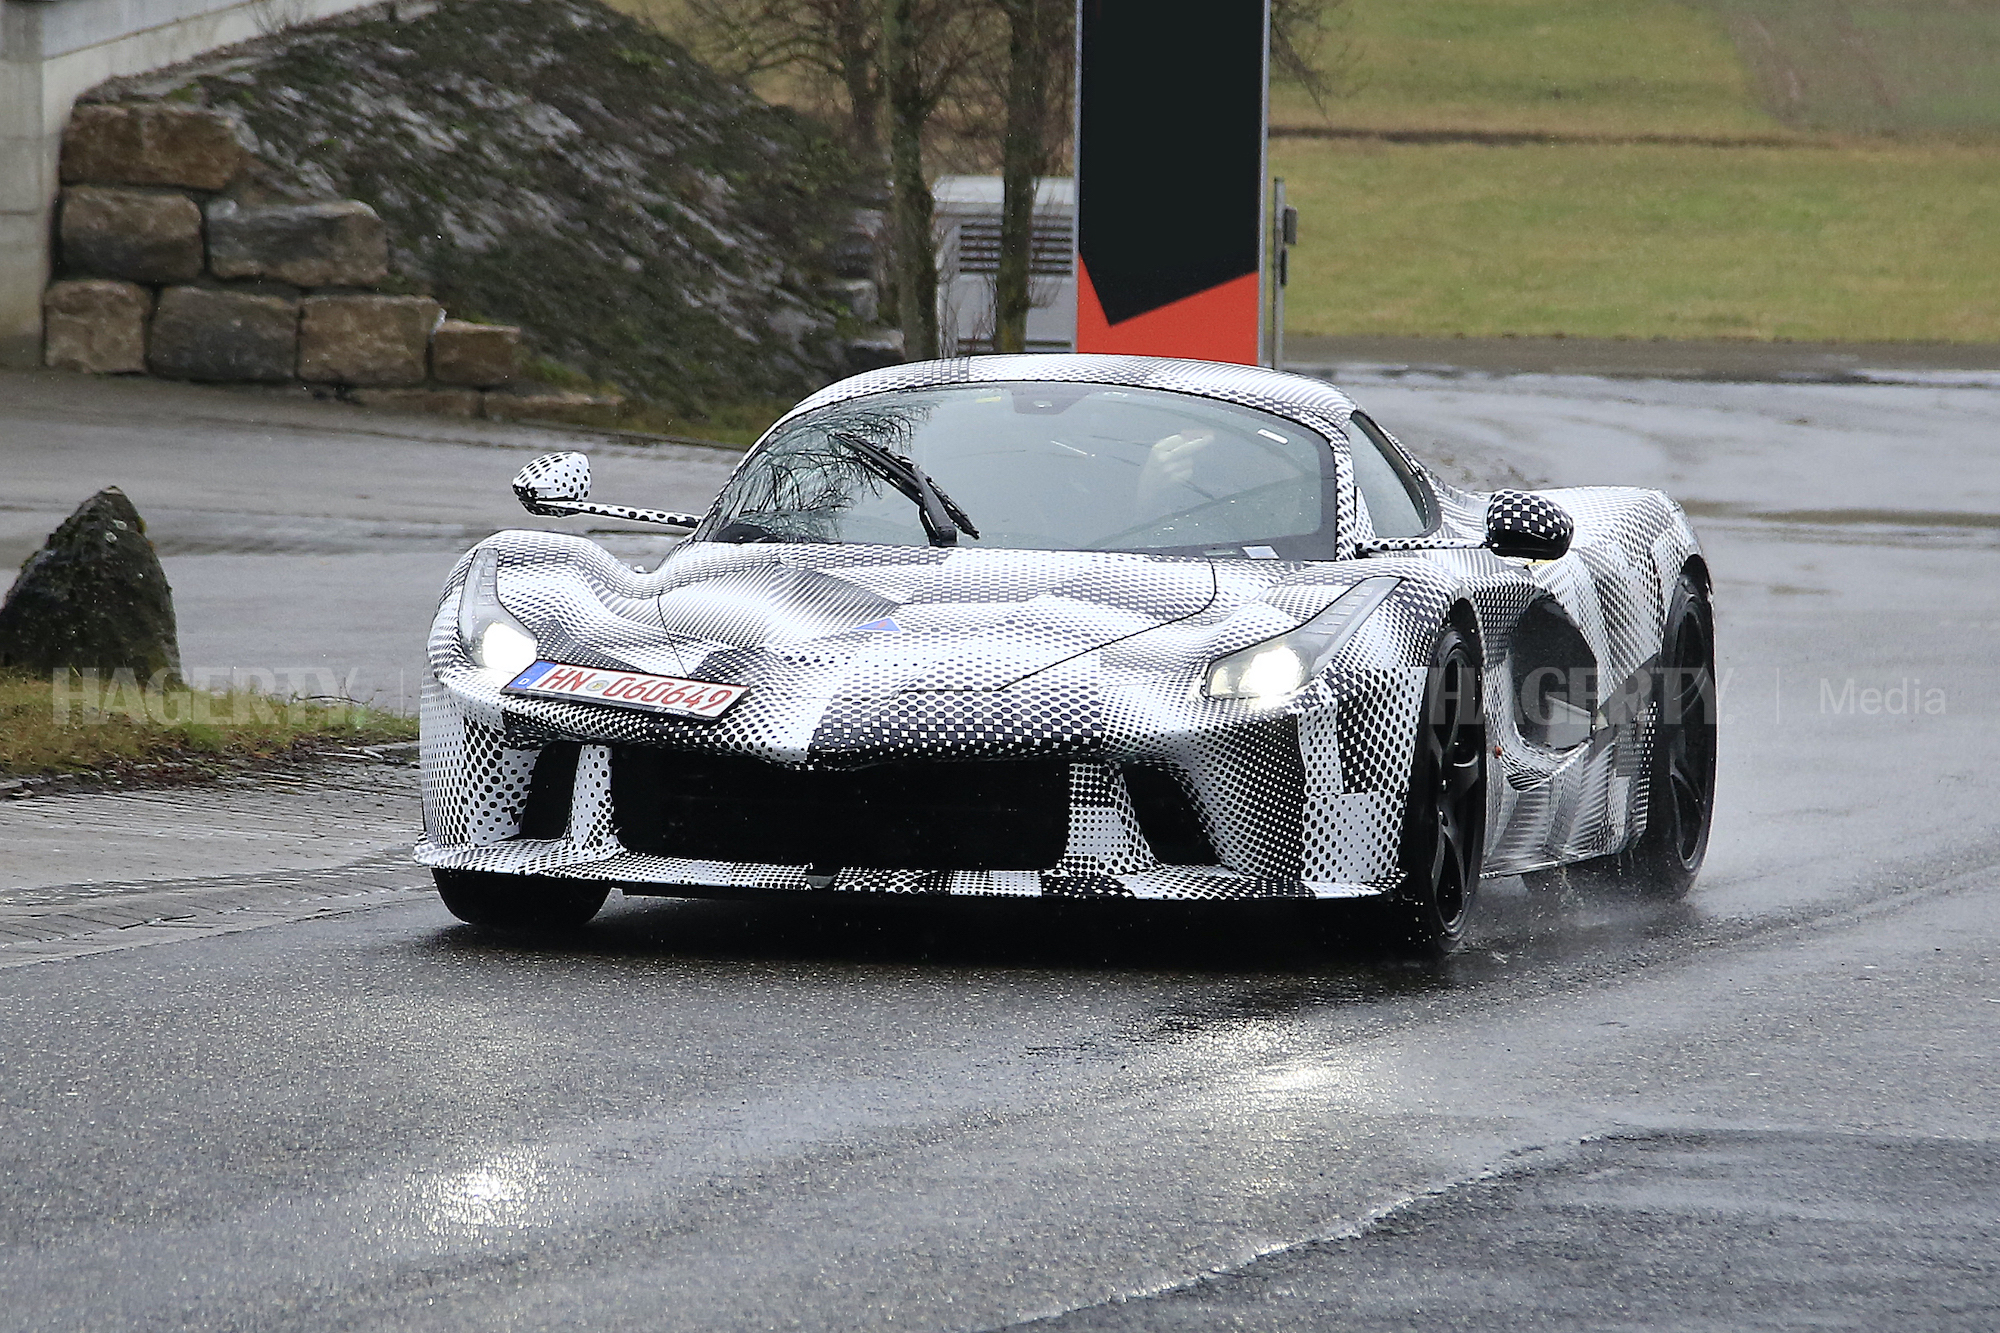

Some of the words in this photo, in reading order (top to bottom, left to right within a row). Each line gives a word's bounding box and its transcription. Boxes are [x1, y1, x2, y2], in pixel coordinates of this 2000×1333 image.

[518, 677, 530, 685] D
[538, 669, 597, 692] HN
[603, 677, 733, 710] 060649
